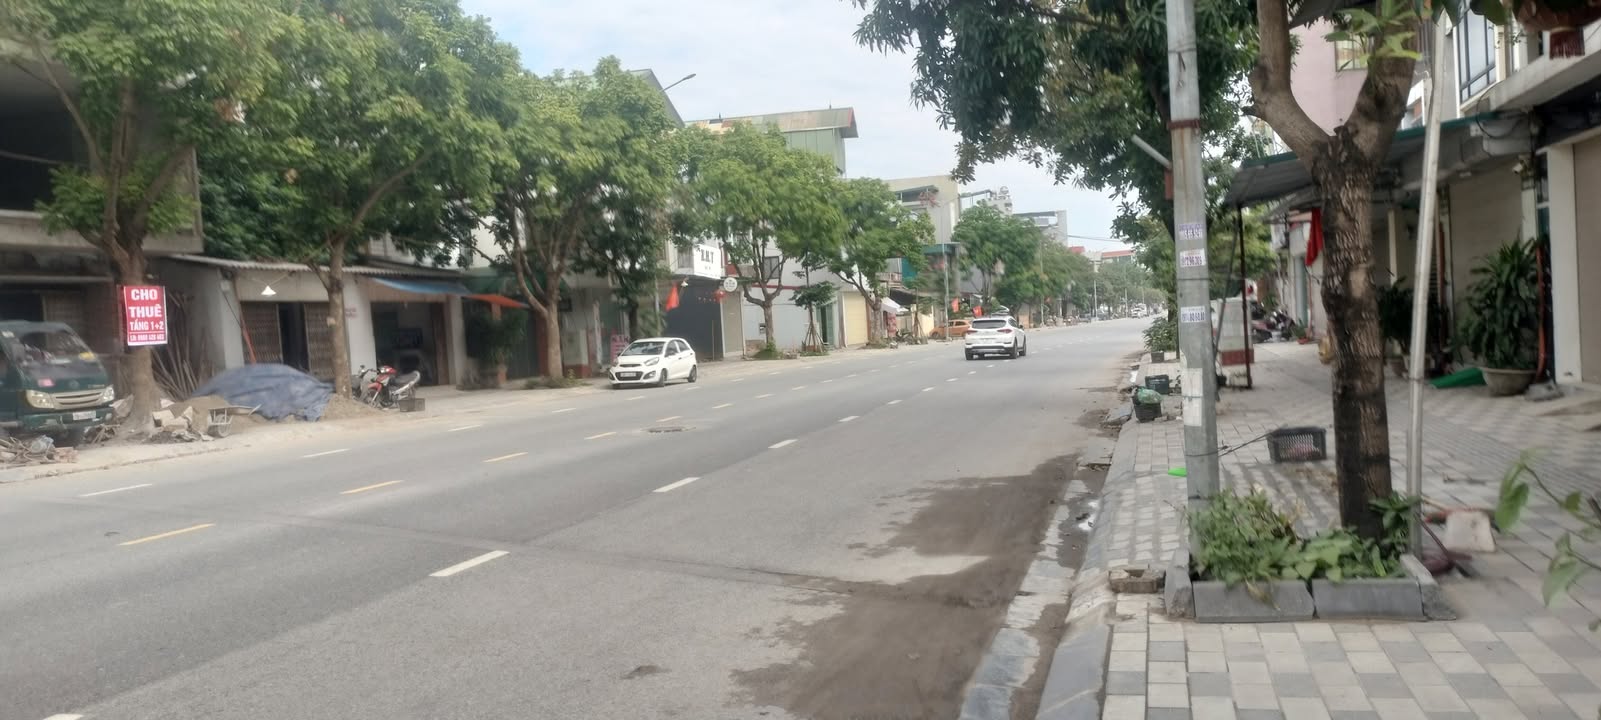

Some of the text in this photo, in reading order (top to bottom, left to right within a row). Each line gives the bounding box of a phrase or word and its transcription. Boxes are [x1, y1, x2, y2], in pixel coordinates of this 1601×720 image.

[131, 288, 158, 301] CHO
[129, 304, 162, 318] THUÊ
[150, 321, 164, 331] 1+2
